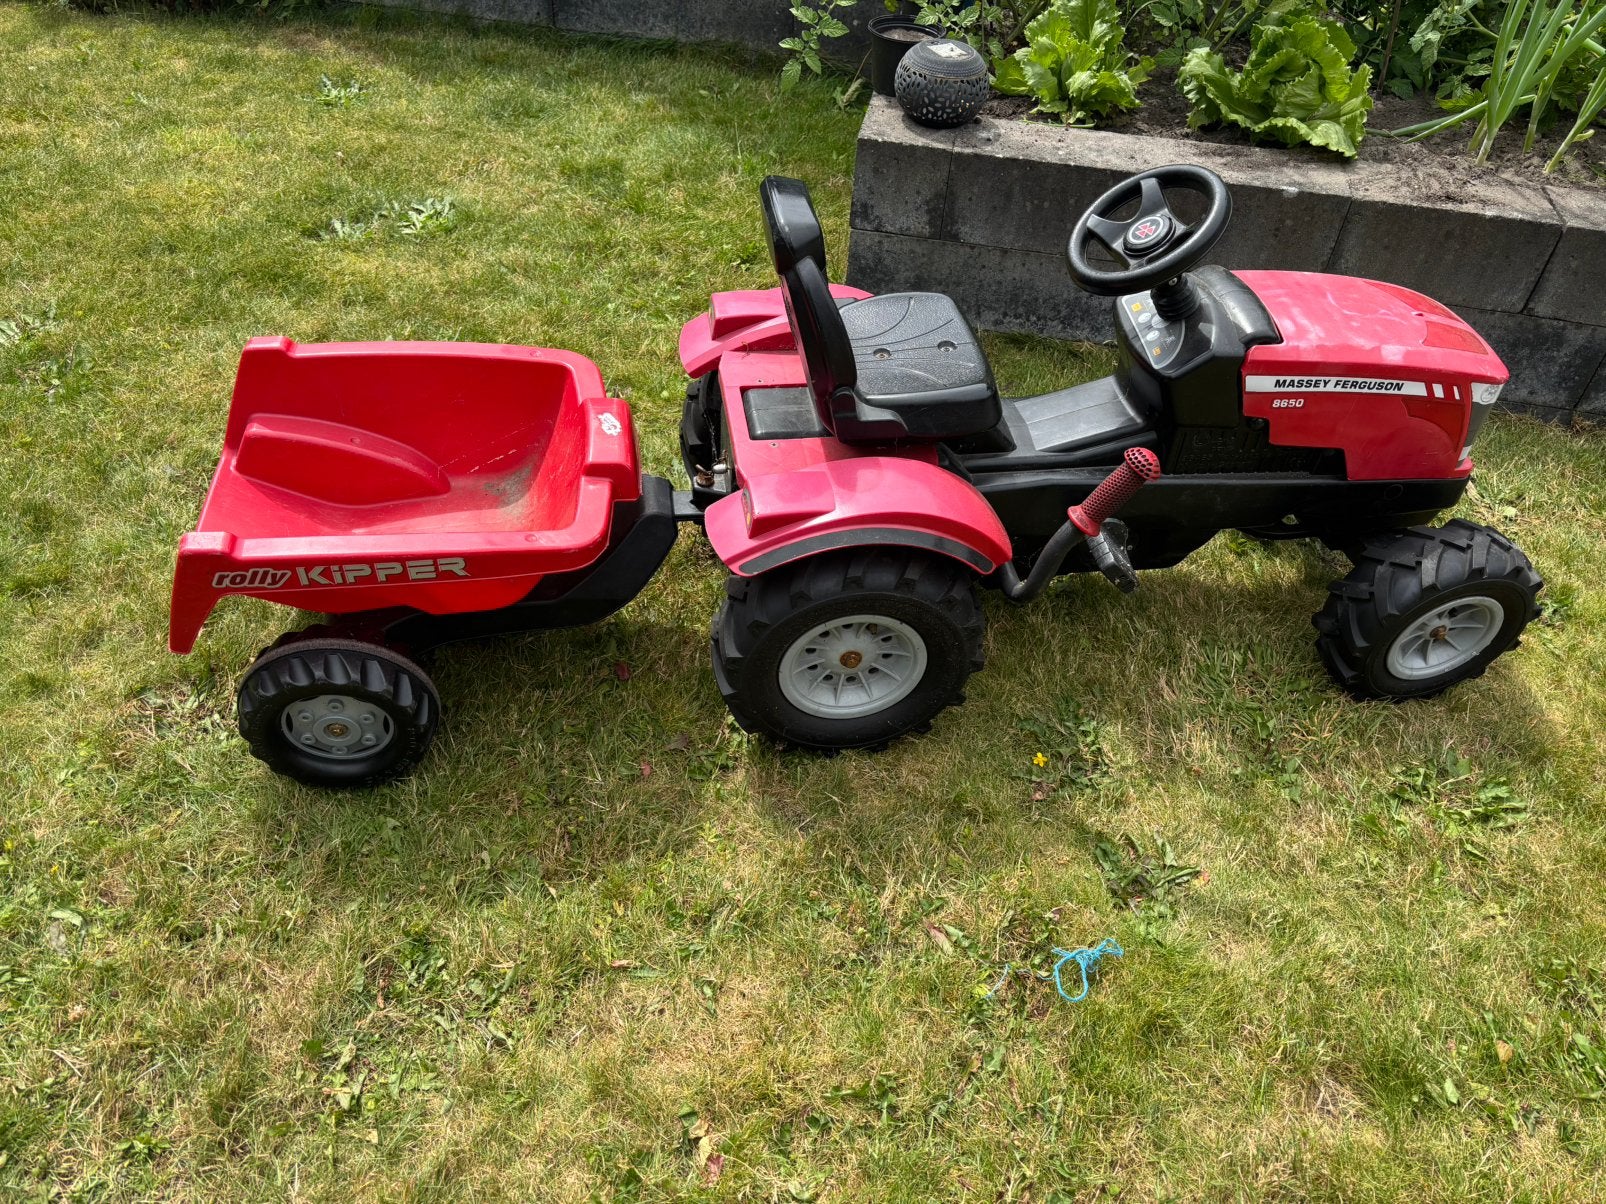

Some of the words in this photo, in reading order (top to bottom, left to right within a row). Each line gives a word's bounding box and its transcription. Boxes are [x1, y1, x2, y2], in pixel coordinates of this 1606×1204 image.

[1274, 379, 1331, 389] MASSEY
[1333, 379, 1404, 391] FERGUSON
[1272, 398, 1304, 408] 8650
[212, 568, 291, 588] rolly
